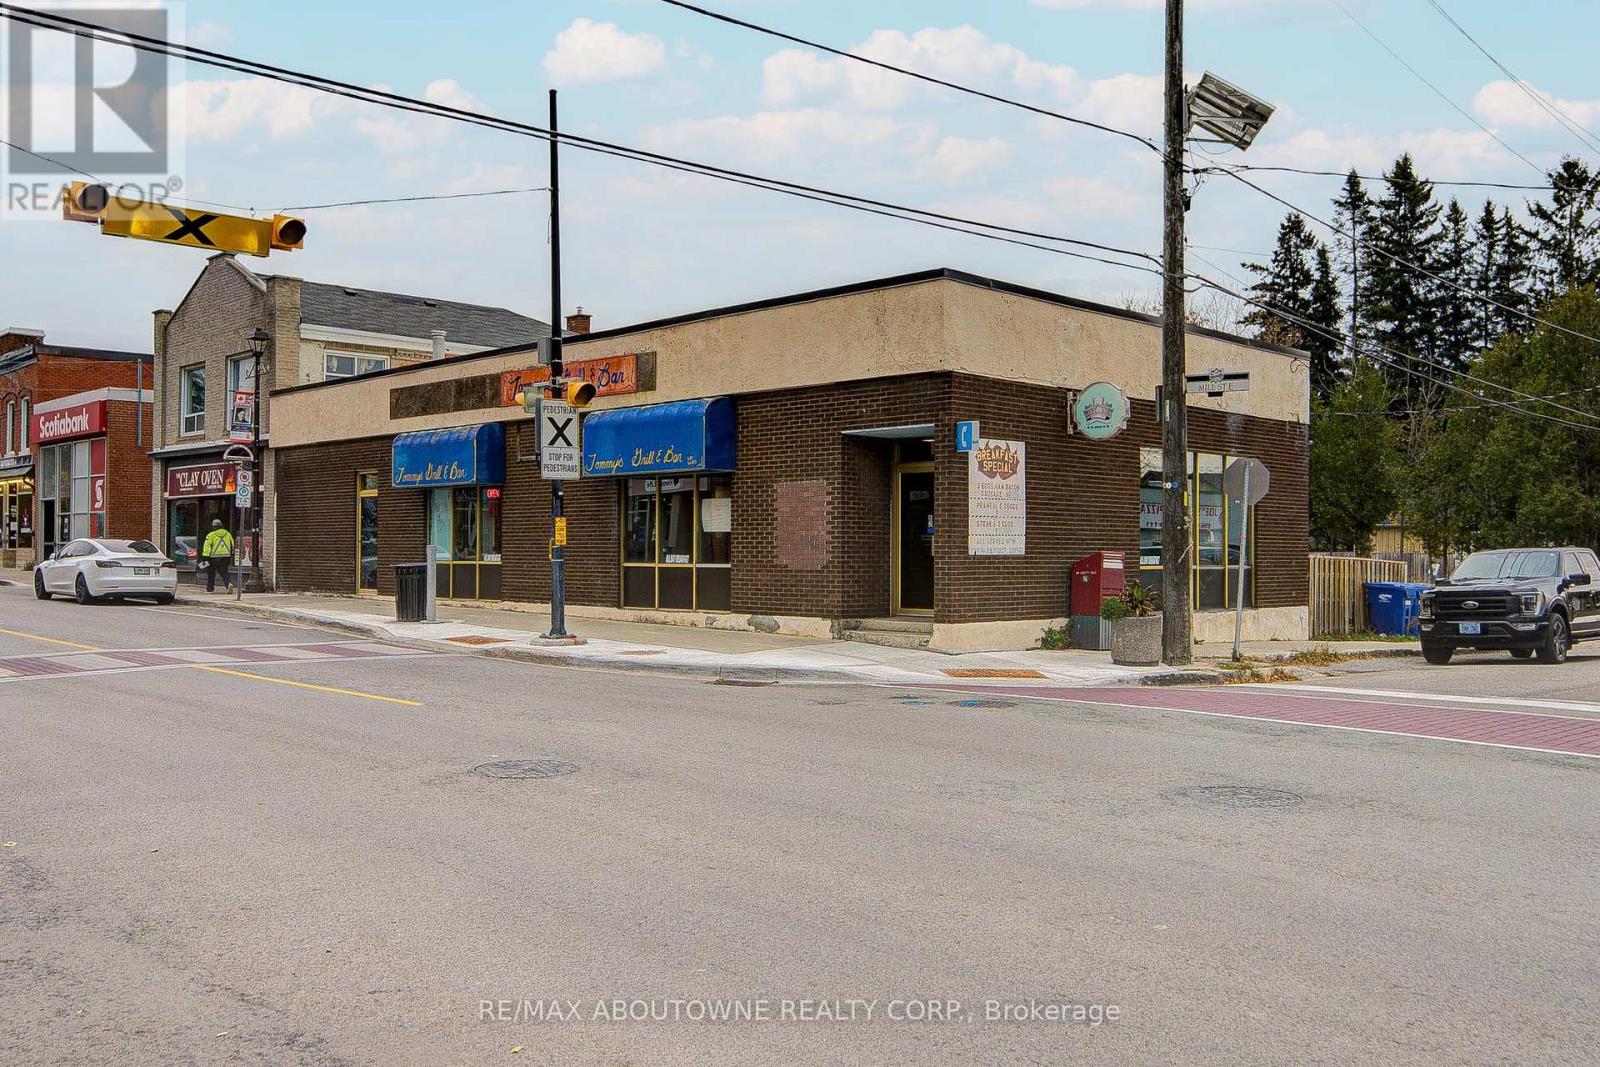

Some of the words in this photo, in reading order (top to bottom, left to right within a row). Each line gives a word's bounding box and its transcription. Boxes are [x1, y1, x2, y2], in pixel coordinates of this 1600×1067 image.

[597, 361, 625, 389] Bar
[543, 405, 577, 415] PEDESTRIAN
[39, 407, 89, 439] Scotiabank
[548, 453, 562, 462] STOP
[563, 453, 574, 462] FOR
[586, 452, 624, 475] Tommy's
[631, 447, 655, 467] Grill
[663, 444, 683, 464] Bar
[976, 449, 1018, 464] BREAKFAST
[425, 461, 443, 480] Grill
[450, 460, 467, 480] Bar
[543, 463, 578, 473] PEDESTRIANS
[983, 460, 1013, 473] SPECIAL
[180, 472, 200, 488] CLAY
[200, 469, 225, 487] OVEN
